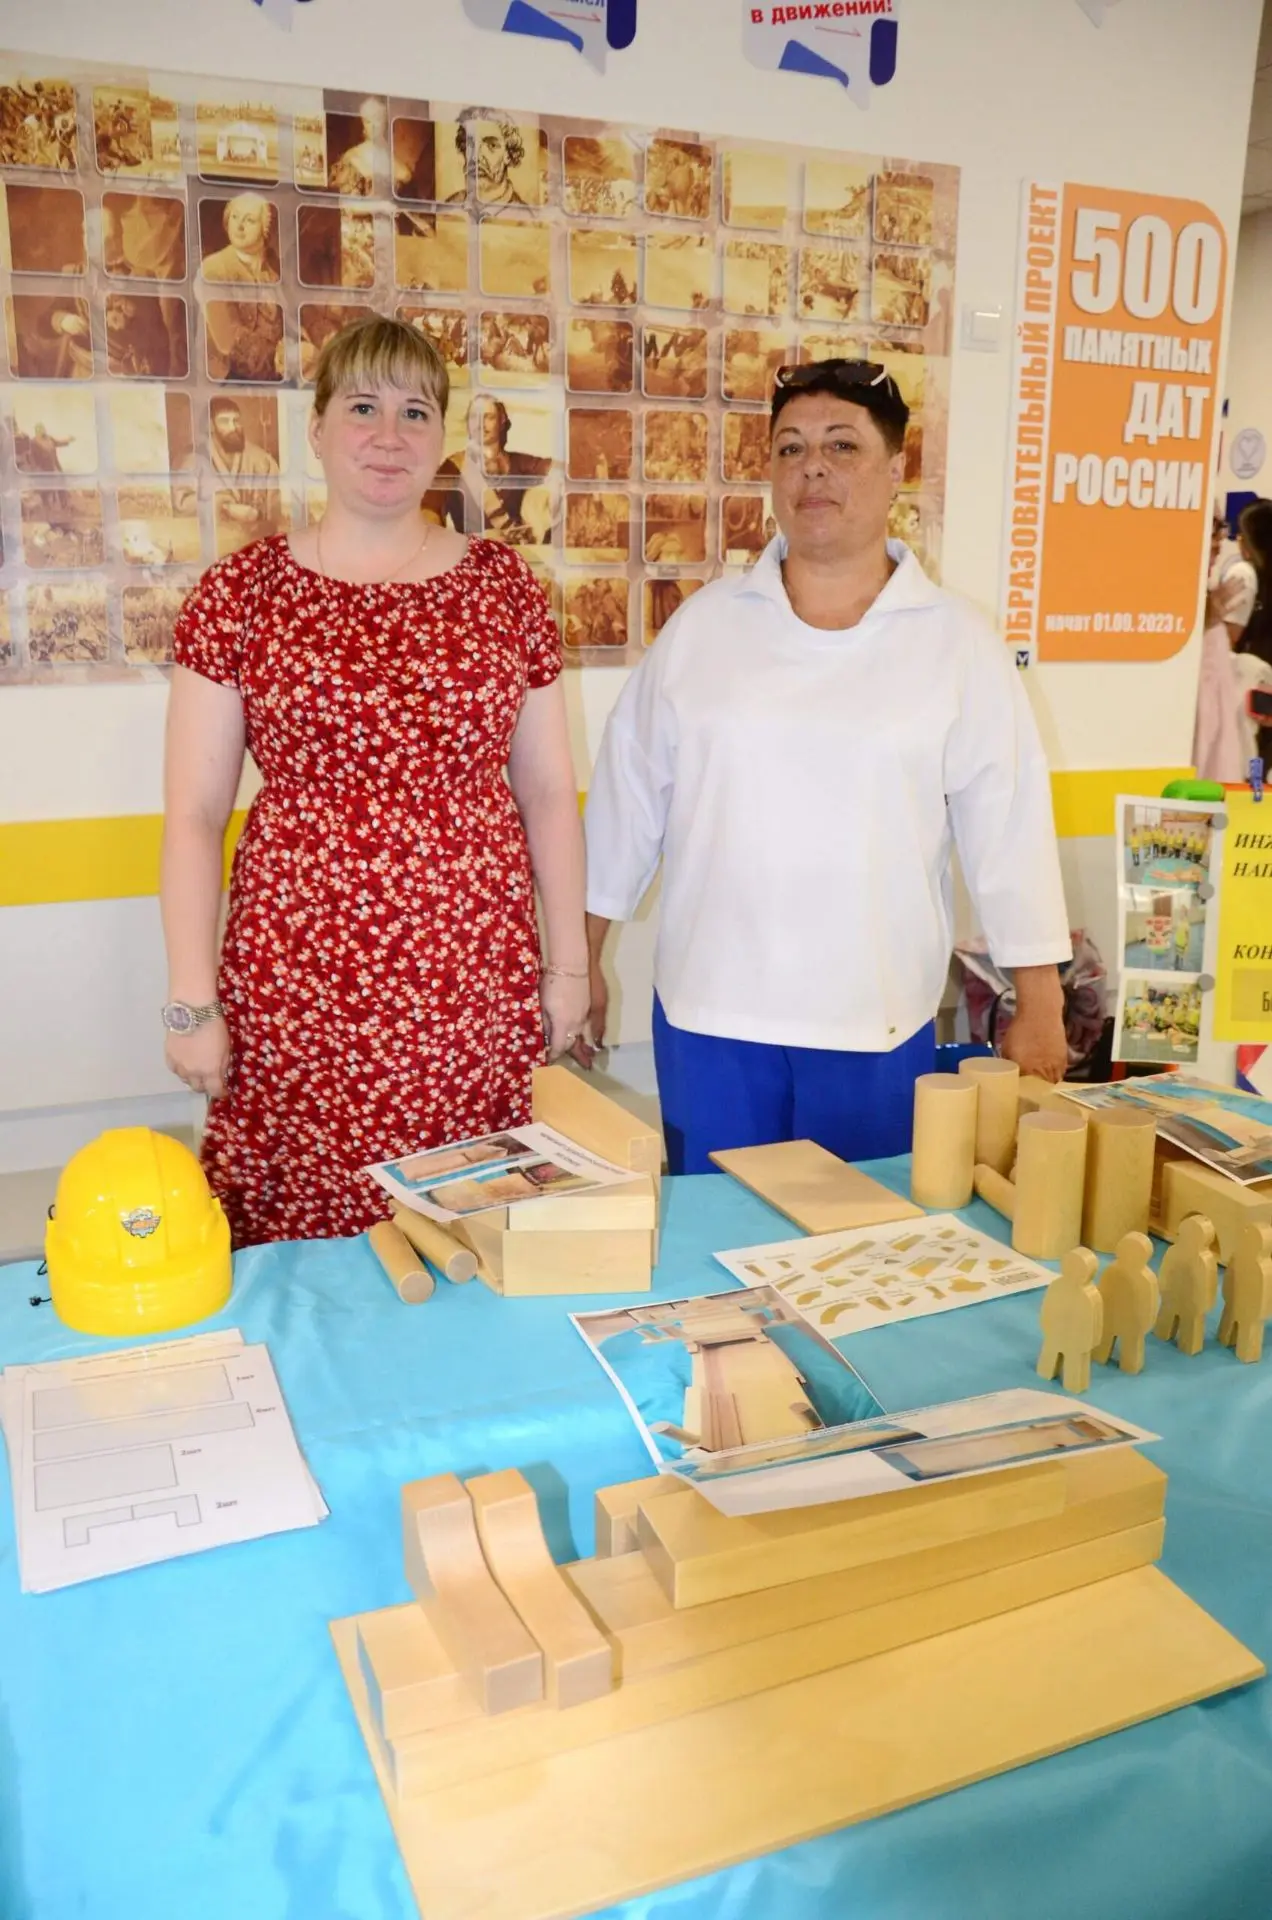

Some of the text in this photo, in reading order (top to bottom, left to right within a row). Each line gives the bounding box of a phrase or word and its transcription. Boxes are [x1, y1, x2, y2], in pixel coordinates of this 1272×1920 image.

[751, 0, 893, 25] в движении!
[1024, 183, 1057, 313] ПРОЕКТ
[1071, 206, 1222, 325] 500
[1063, 326, 1212, 374] ПАМЯТНЫХ
[1123, 381, 1210, 444] ДАТ
[1052, 453, 1203, 511] РОССИИ
[1137, 612, 1174, 633] 2023
